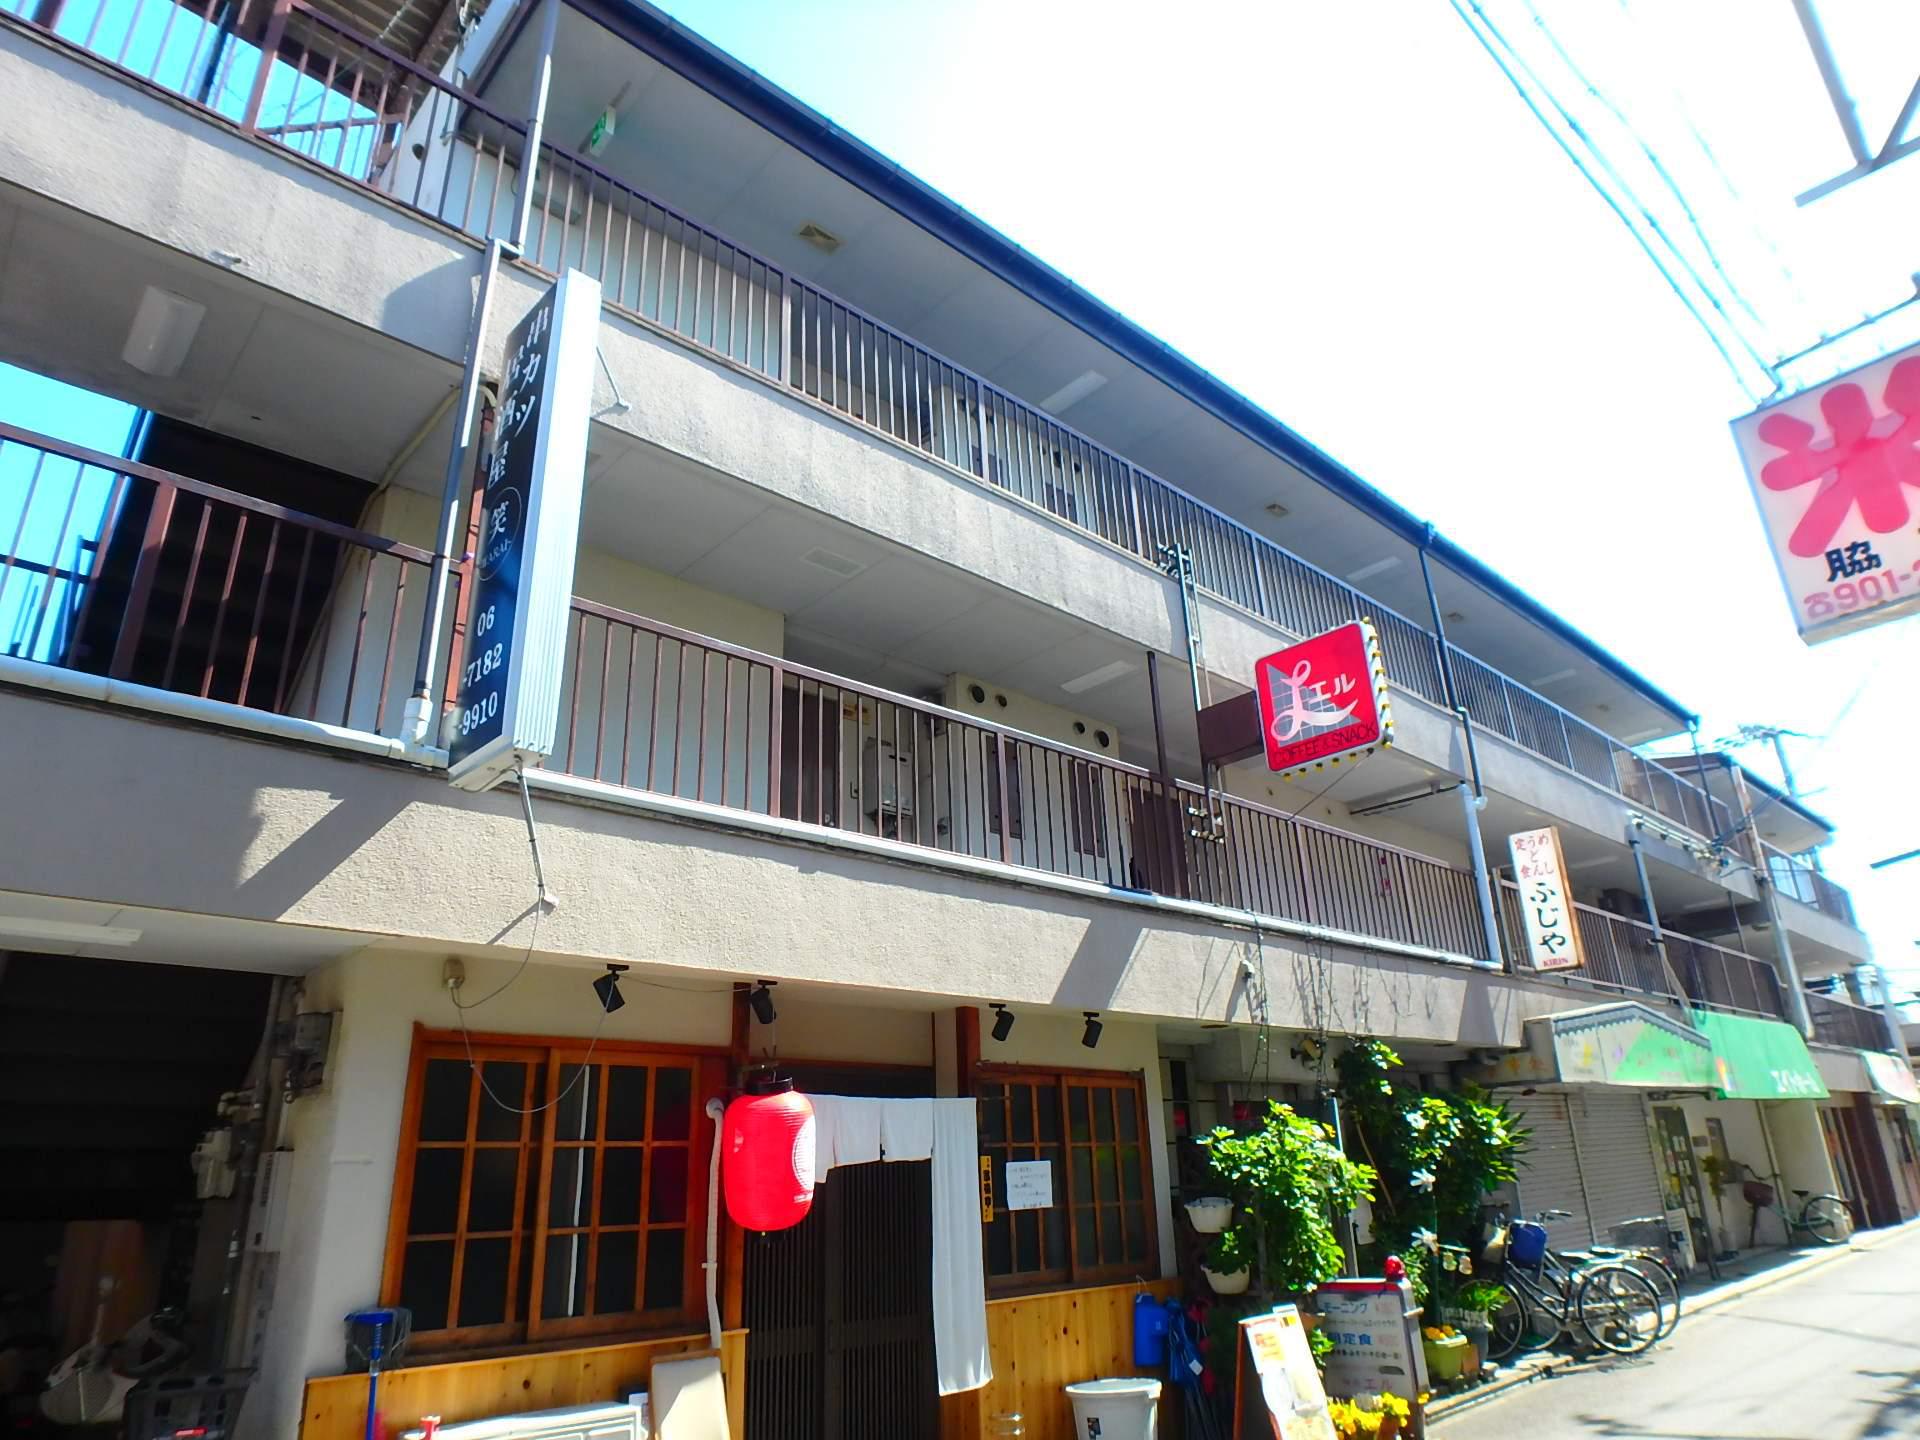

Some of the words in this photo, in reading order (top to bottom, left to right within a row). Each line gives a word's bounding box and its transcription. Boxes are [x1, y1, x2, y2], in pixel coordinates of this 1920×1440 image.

[514, 306, 549, 437] 串カツ
[487, 345, 525, 489] 居酒屋
[477, 605, 495, 637] 06
[1309, 673, 1356, 704] エル
[1273, 738, 1321, 765] COFFEE
[1332, 722, 1377, 749] SNACK
[1530, 882, 1567, 954] ふじや
[1543, 957, 1569, 967] KIRIN
